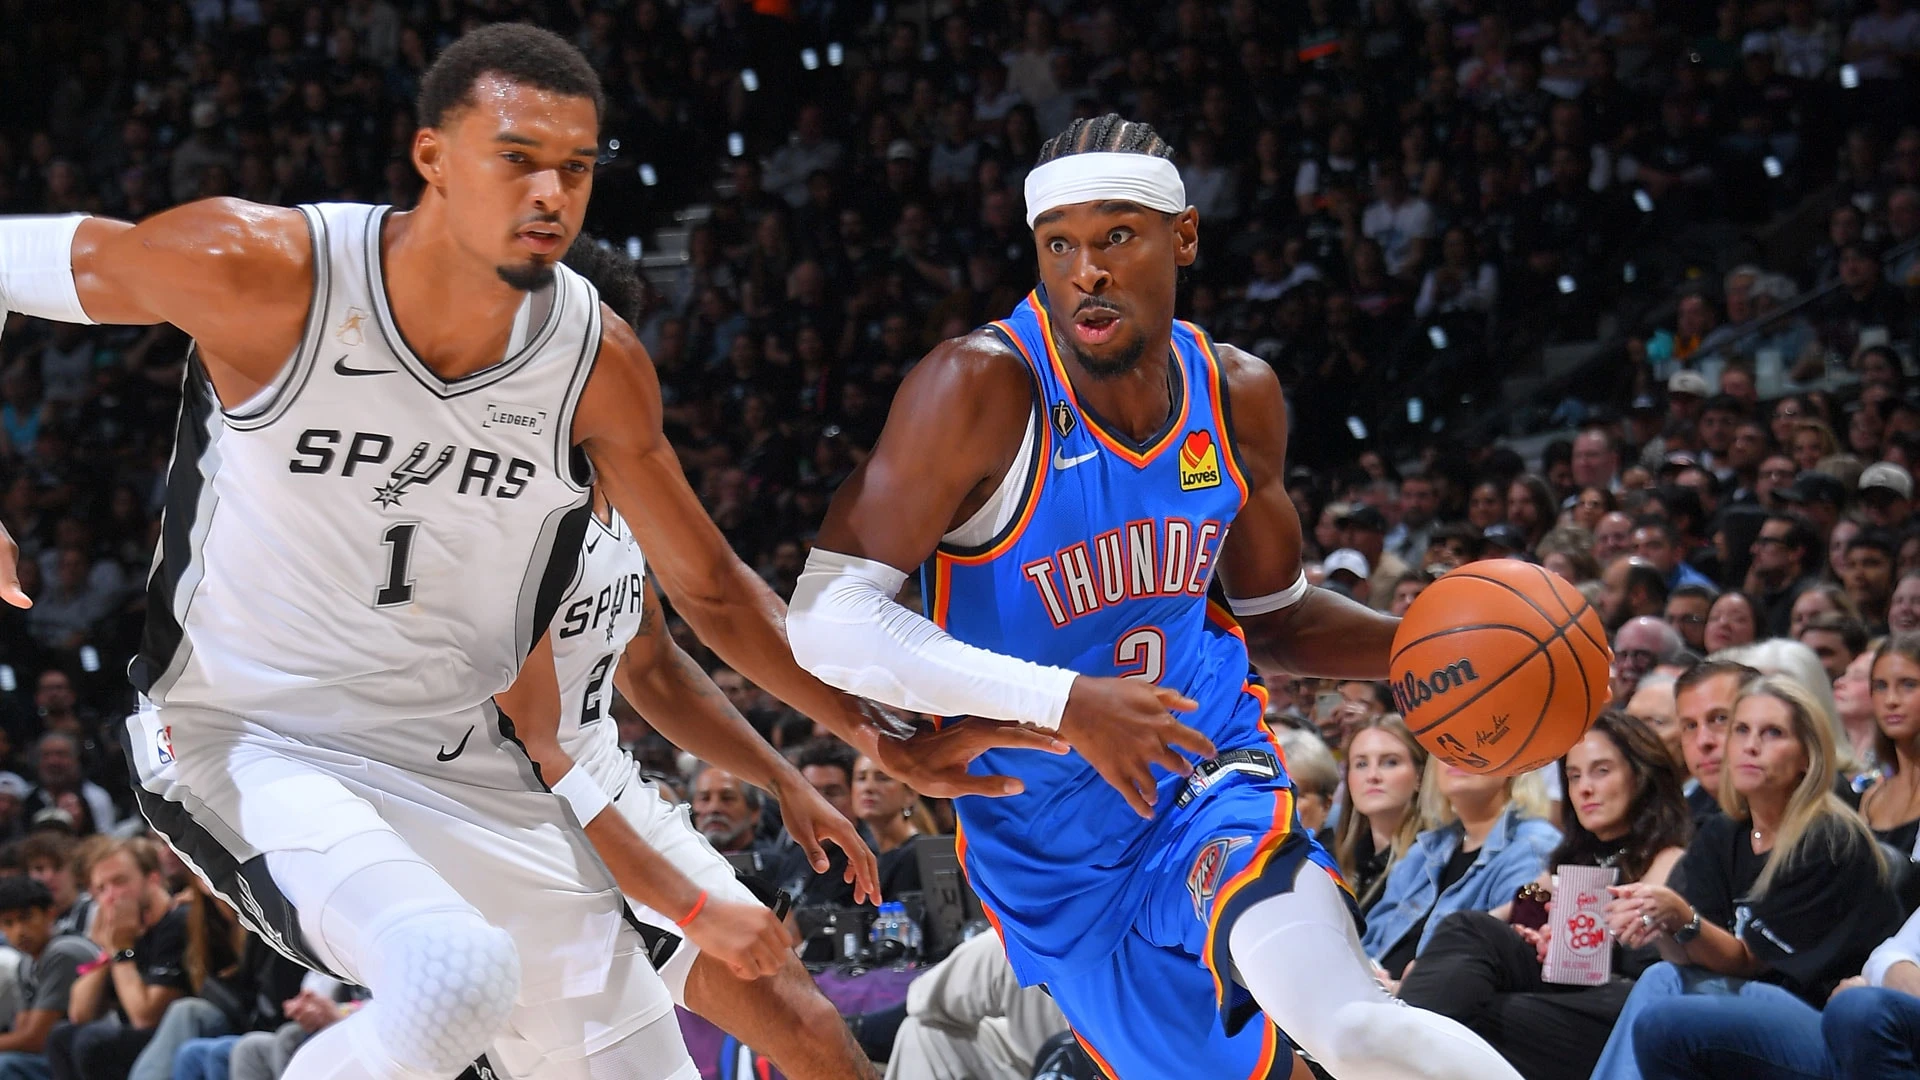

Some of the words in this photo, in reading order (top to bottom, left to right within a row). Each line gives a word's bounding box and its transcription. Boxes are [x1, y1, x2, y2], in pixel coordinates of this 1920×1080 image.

[492, 412, 537, 428] LEDGER
[288, 428, 537, 509] SPURS
[373, 521, 421, 609] 1
[1022, 516, 1231, 629] THUNDE
[559, 573, 645, 643] SPUR
[1114, 625, 1166, 685] 2
[1568, 914, 1595, 933] POP
[1571, 928, 1604, 949] CORN
